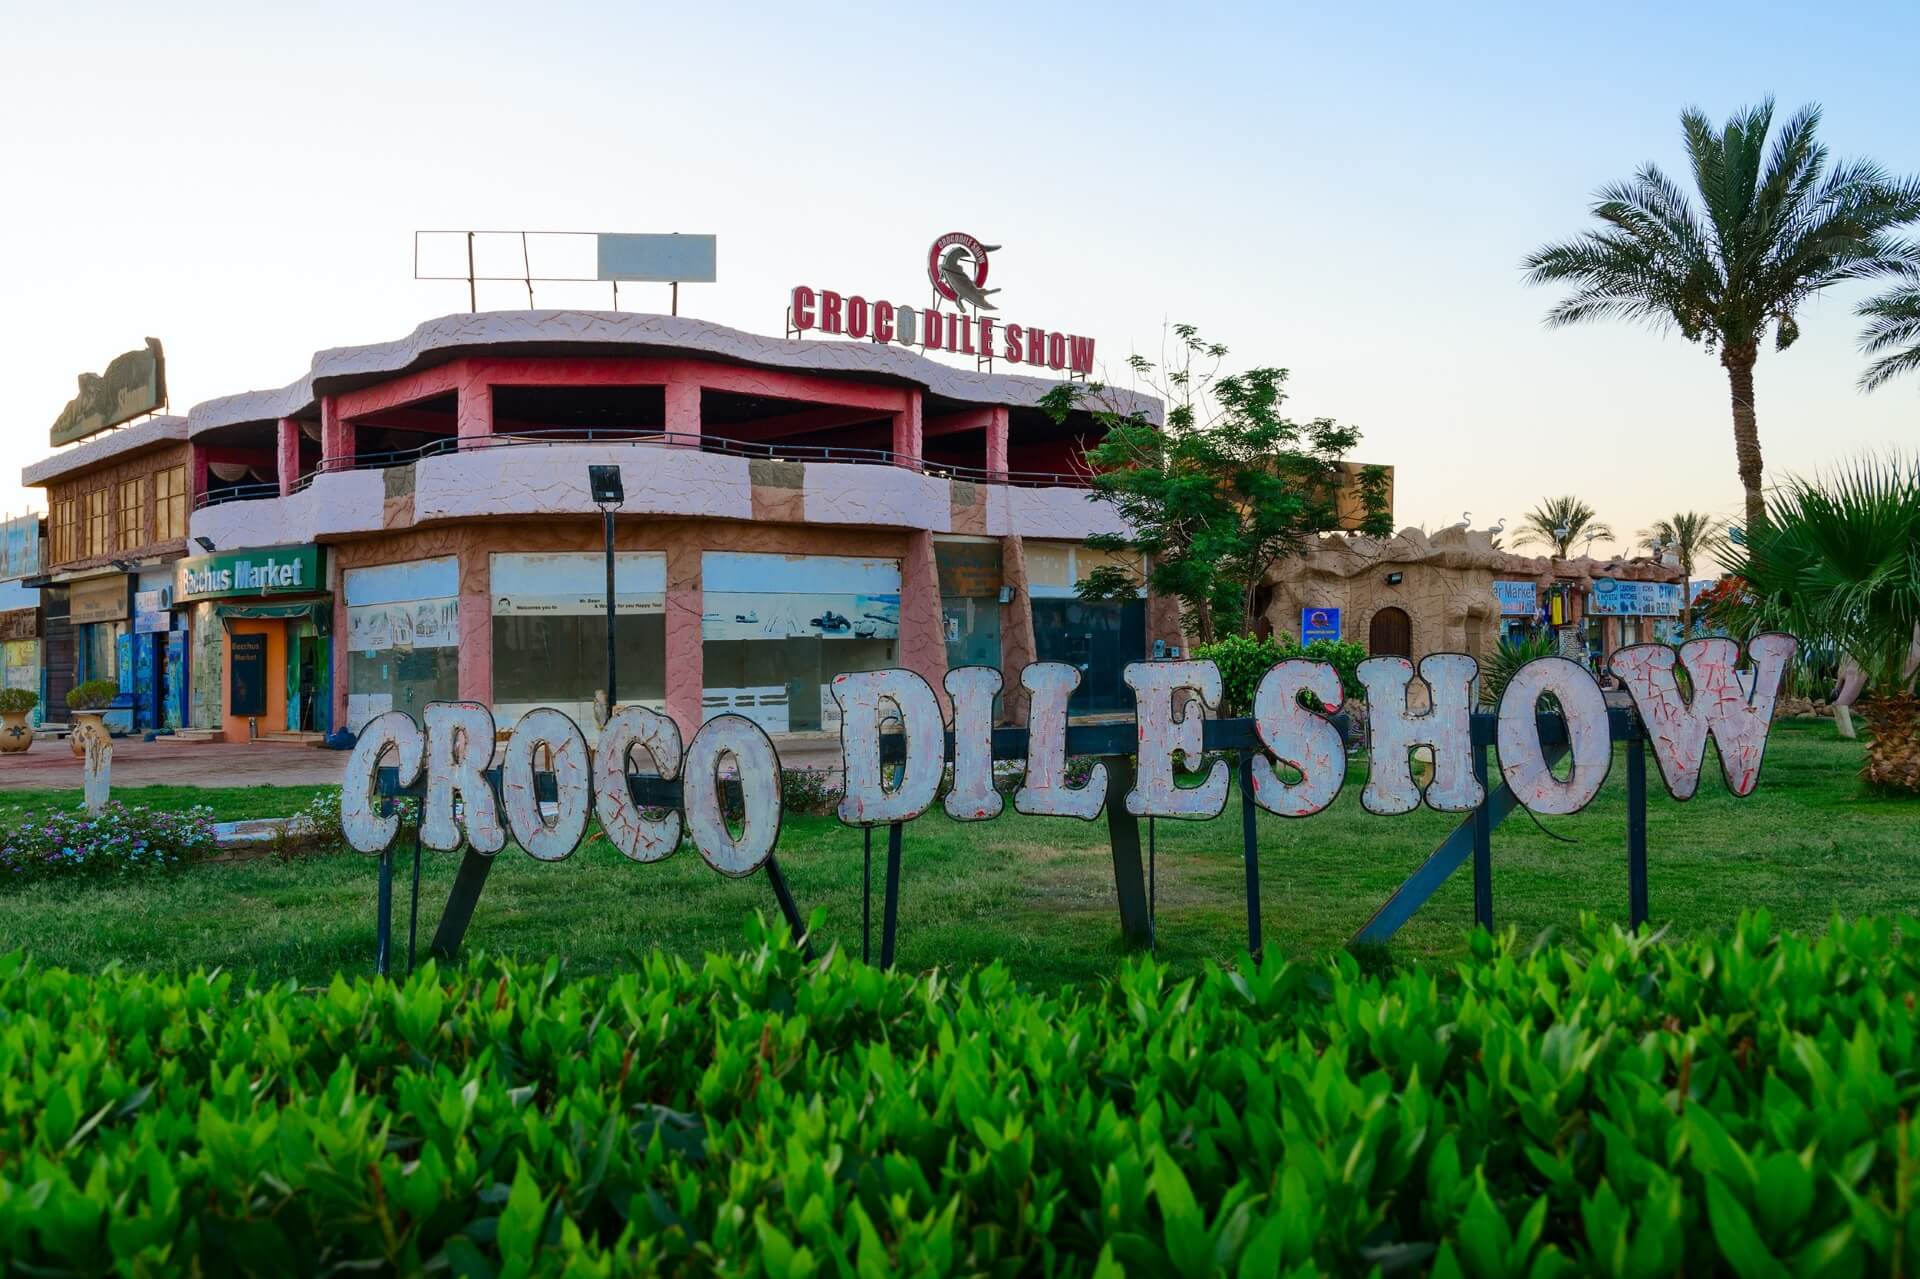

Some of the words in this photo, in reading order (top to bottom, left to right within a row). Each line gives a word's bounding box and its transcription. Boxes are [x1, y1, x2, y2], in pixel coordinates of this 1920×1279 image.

[790, 285, 994, 358] CROCODILE
[1004, 323, 1096, 375] SHOW
[183, 564, 232, 595] Bacchus
[234, 557, 303, 589] Market
[1504, 583, 1536, 599] Market
[1252, 632, 1799, 819] SHOW
